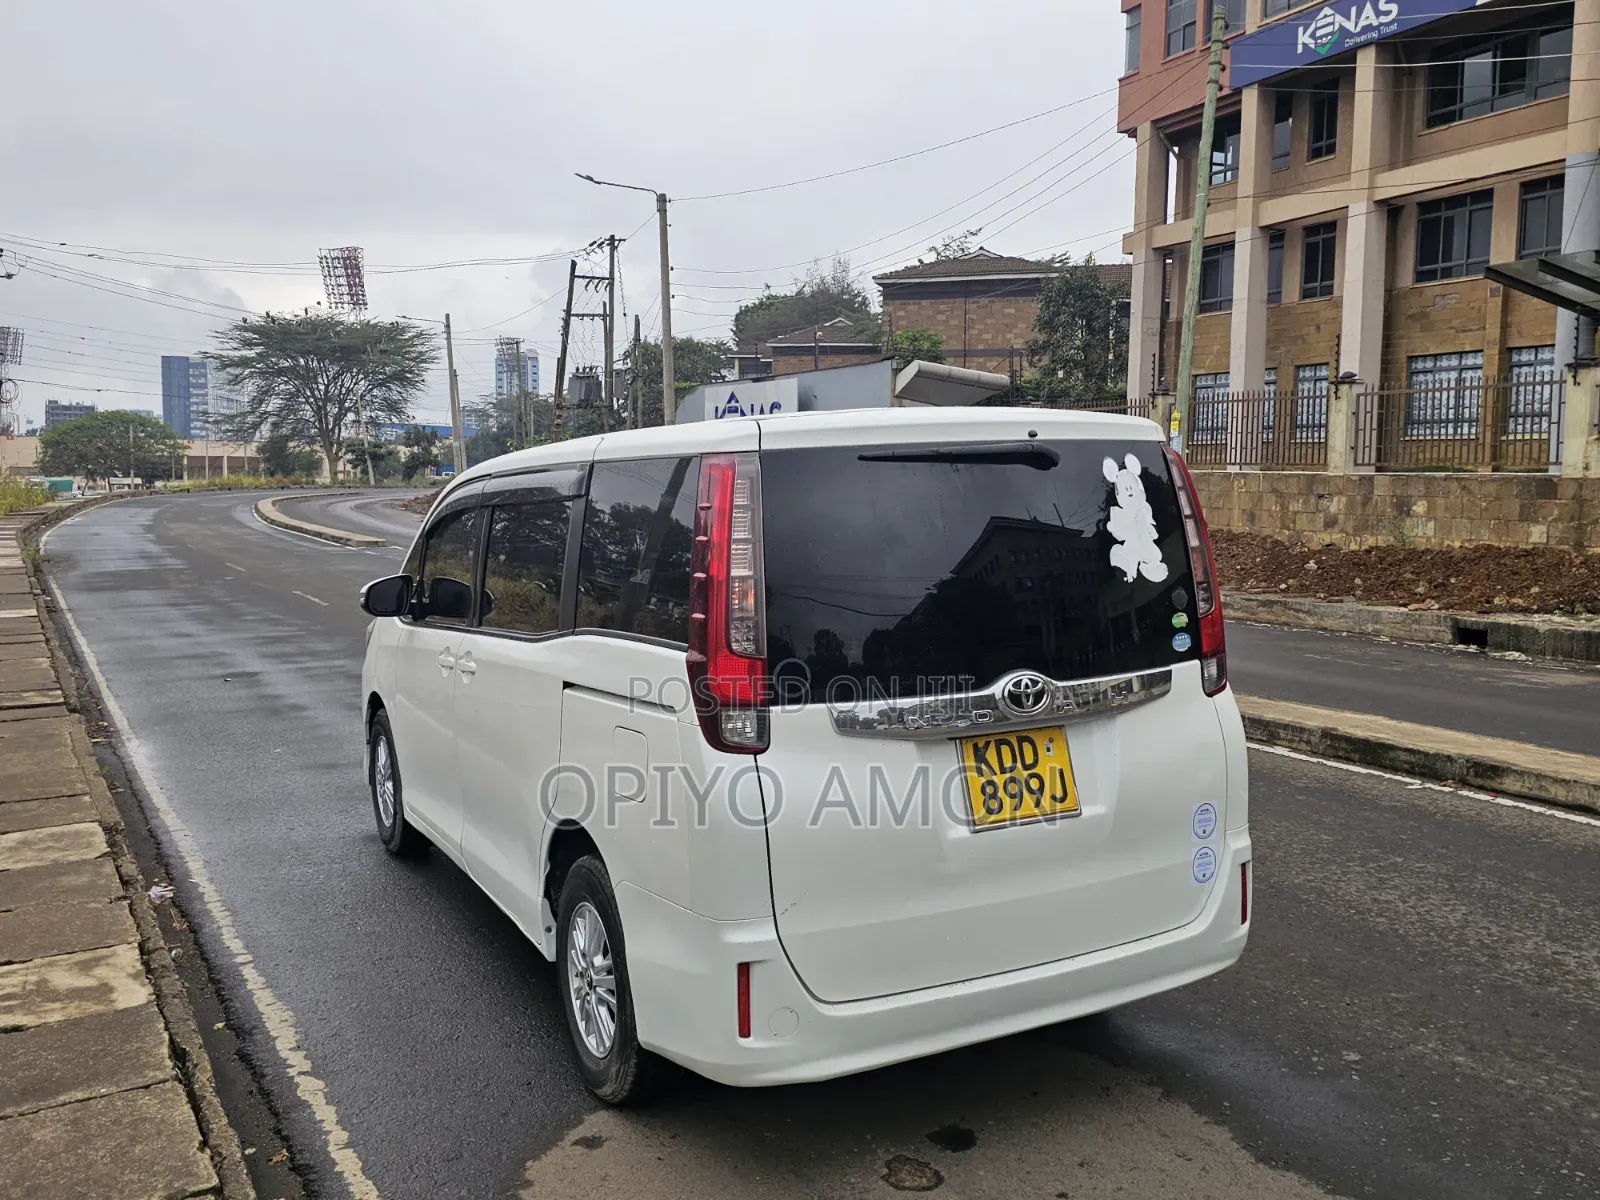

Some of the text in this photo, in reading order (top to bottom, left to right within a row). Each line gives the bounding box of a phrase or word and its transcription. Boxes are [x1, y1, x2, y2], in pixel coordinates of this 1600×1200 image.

[1297, 0, 1399, 54] KENAS
[1344, 22, 1398, 47] Delivering Trust
[972, 735, 1039, 777] KDD
[980, 768, 1068, 815] 899J
